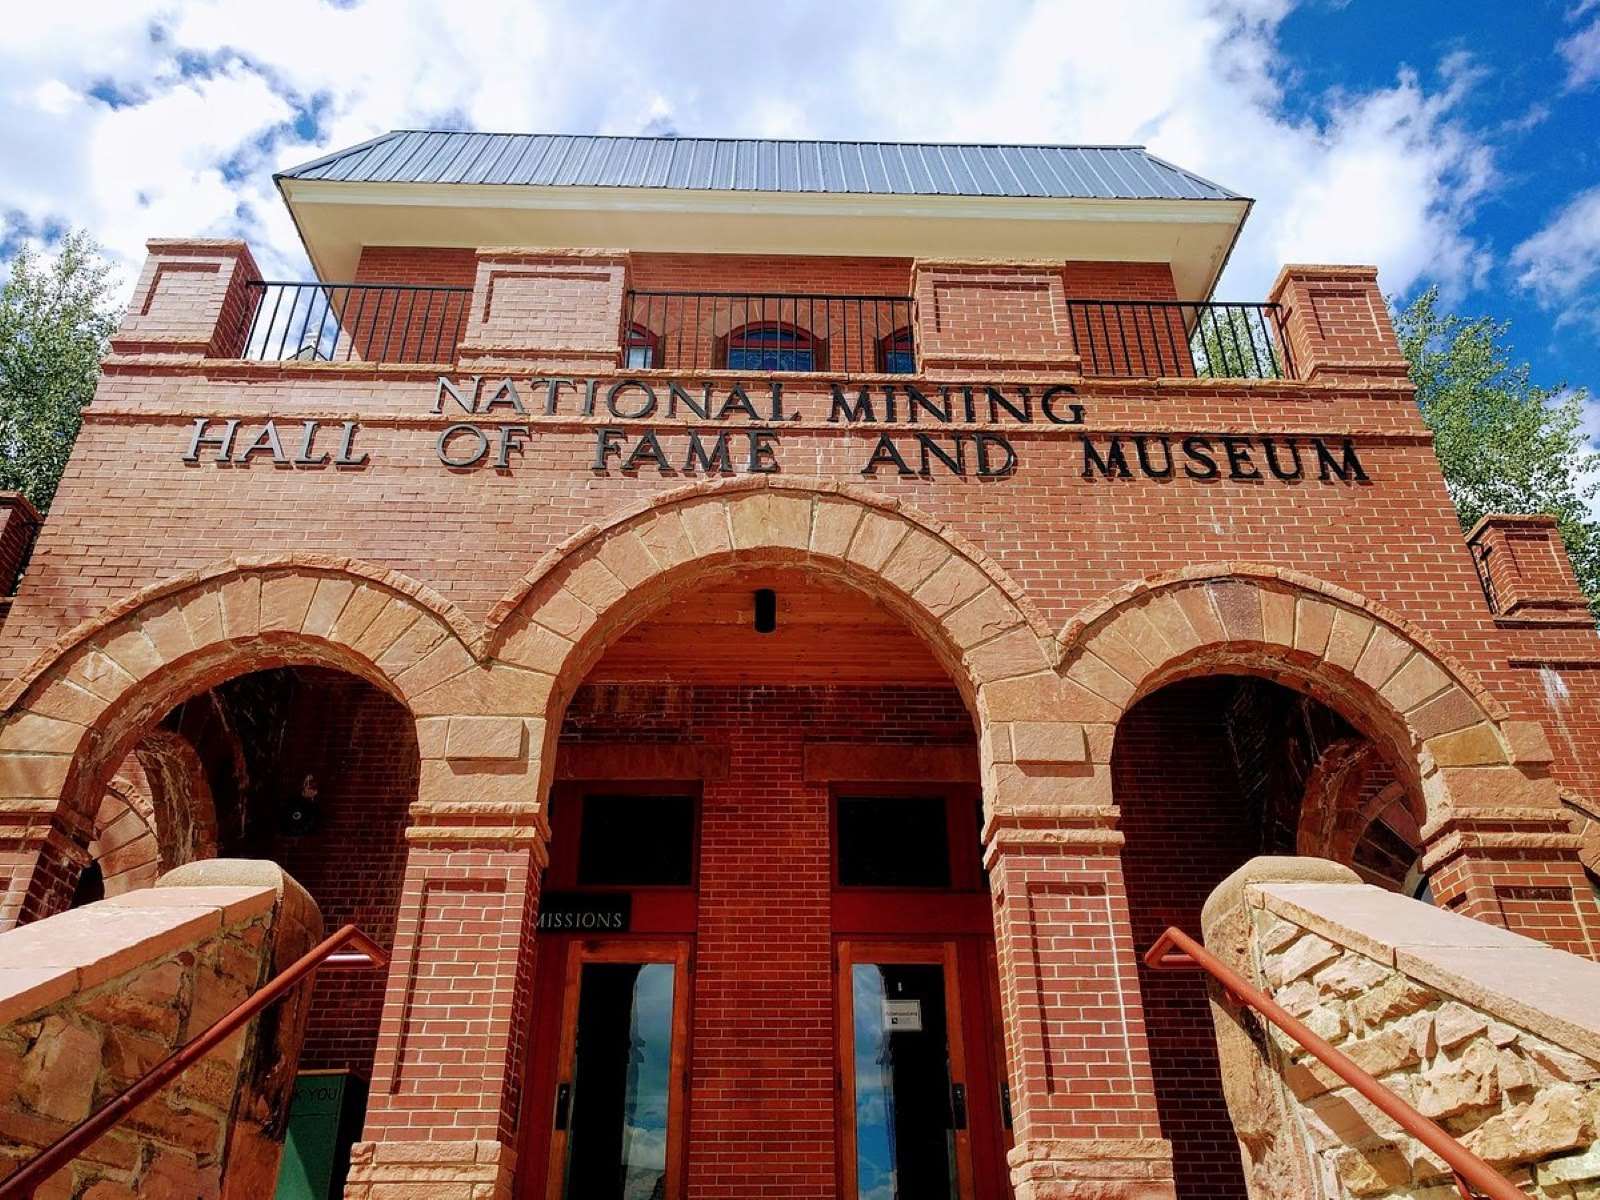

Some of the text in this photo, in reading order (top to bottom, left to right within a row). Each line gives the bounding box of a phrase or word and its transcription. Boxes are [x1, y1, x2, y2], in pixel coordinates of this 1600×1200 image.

[429, 375, 1086, 424] NATIONAL MINING
[181, 418, 1371, 483] HALL OF FAME AND MUSEUM
